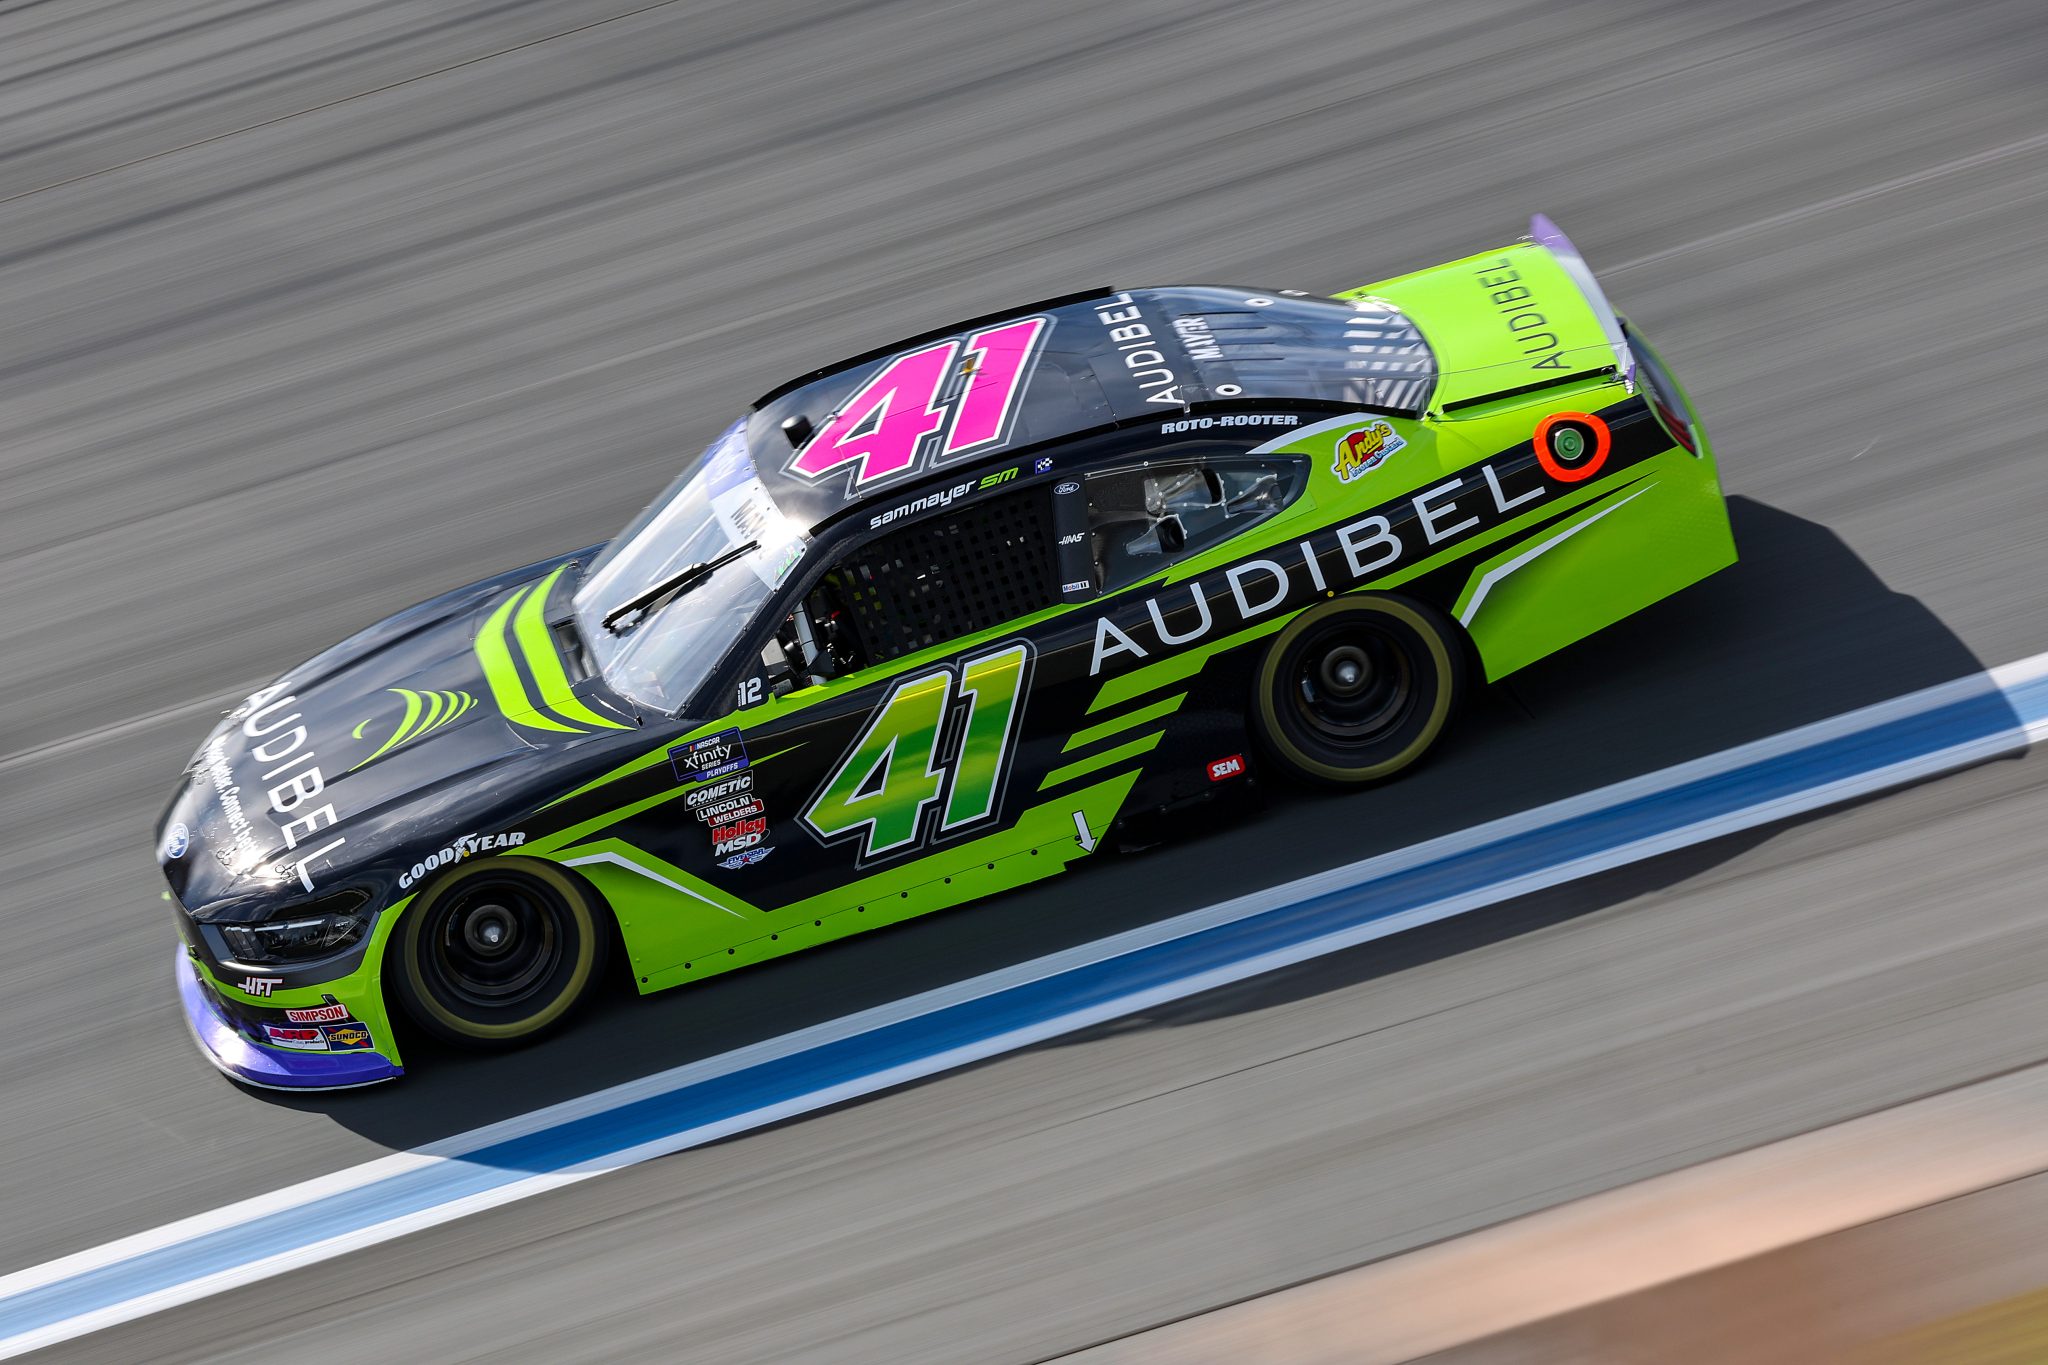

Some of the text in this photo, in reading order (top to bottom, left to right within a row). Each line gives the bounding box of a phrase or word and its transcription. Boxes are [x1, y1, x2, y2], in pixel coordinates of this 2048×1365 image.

[1472, 258, 1572, 371] AUDIBEL
[1094, 293, 1186, 405] AUDIBEL
[1173, 316, 1224, 361] MAYER
[788, 317, 1047, 487] 41
[1161, 415, 1299, 434] ROTO-ROOTER
[1335, 424, 1392, 480] Andy's
[1056, 482, 1078, 494] Ford
[1058, 532, 1085, 545] HAAS
[1089, 464, 1545, 676] AUDIBEL
[1063, 583, 1080, 592] Mobil
[739, 676, 762, 706] 12
[684, 743, 731, 769] xfinity
[695, 736, 720, 750] NASCAR
[803, 643, 1028, 857] 41
[701, 760, 721, 770] SERIES
[706, 762, 738, 778] PLAYOFFS
[1212, 759, 1240, 777] SEM
[240, 681, 346, 893] AUDIBEL
[686, 776, 751, 805] COMETIC
[220, 785, 248, 834] Connect
[700, 796, 750, 819] LINCOLN
[713, 805, 758, 823] WELDERS
[713, 817, 766, 845] Holley
[715, 833, 761, 857] MSD
[399, 831, 526, 889] GOODYEAR
[289, 1006, 345, 1022] SIMPSON
[330, 1031, 367, 1041] SUNOCO
